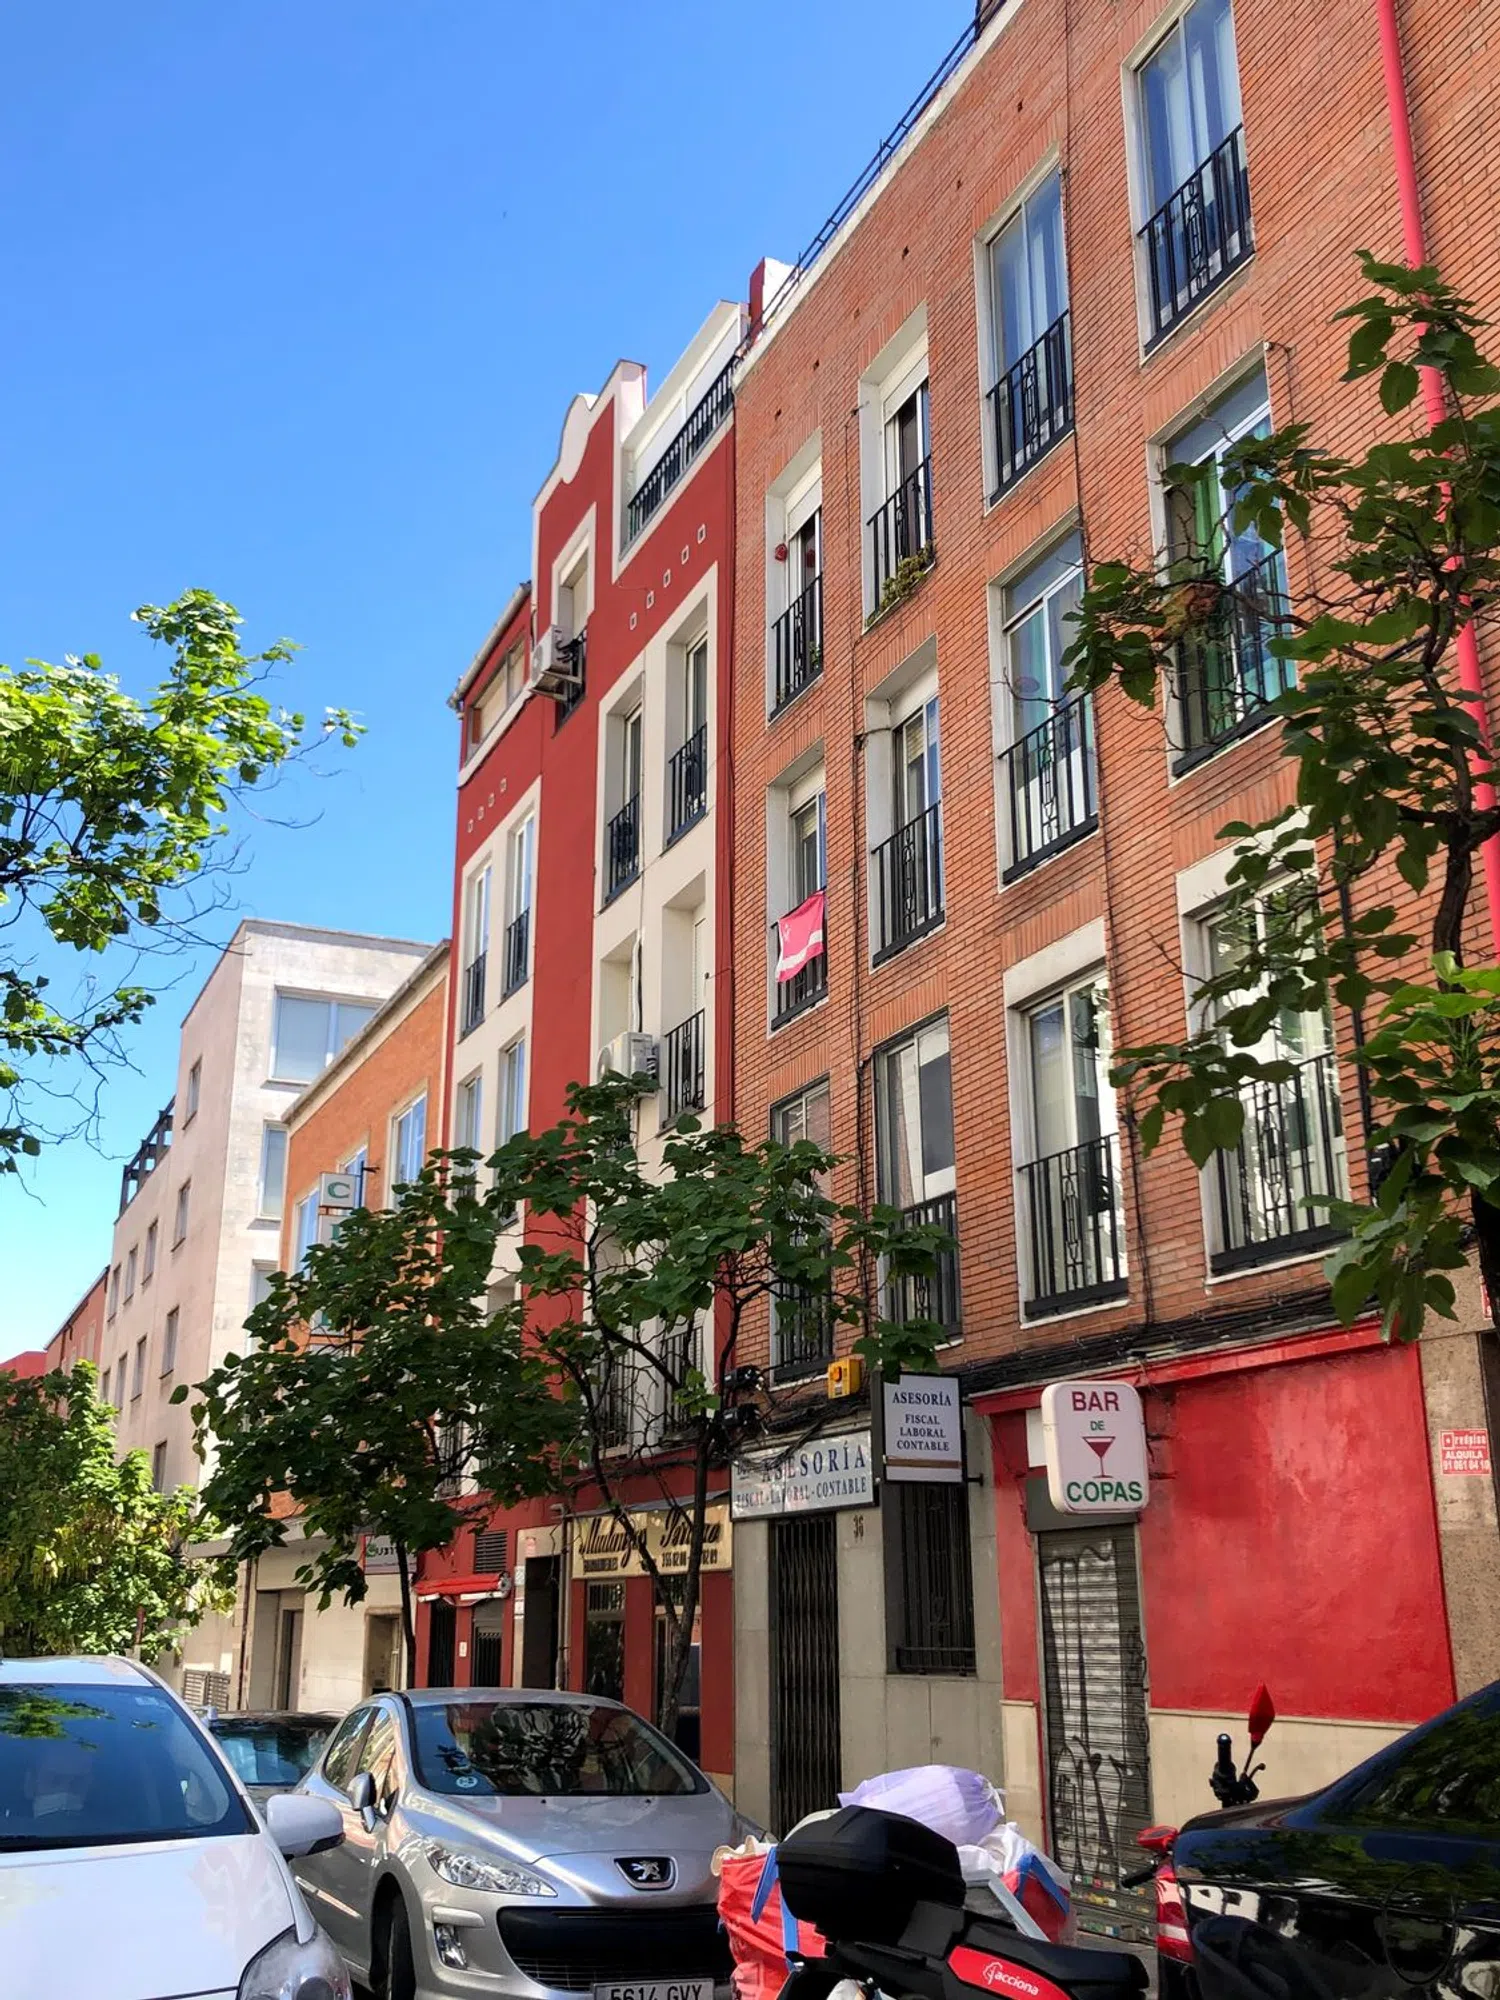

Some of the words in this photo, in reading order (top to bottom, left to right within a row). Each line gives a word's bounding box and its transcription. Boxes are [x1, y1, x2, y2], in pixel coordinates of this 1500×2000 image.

[892, 1391, 952, 1406] ASESORÍA
[1072, 1391, 1120, 1411] BAR
[905, 1413, 941, 1425] FISCAL
[1090, 1420, 1106, 1431] DE
[900, 1427, 947, 1439] LABORAL
[896, 1440, 950, 1452] CONTABLE
[1445, 1450, 1484, 1460] ALQUILA
[1067, 1481, 1143, 1502] COPAS
[994, 1970, 1039, 1995] acciona
[667, 1984, 702, 2000] GVY
